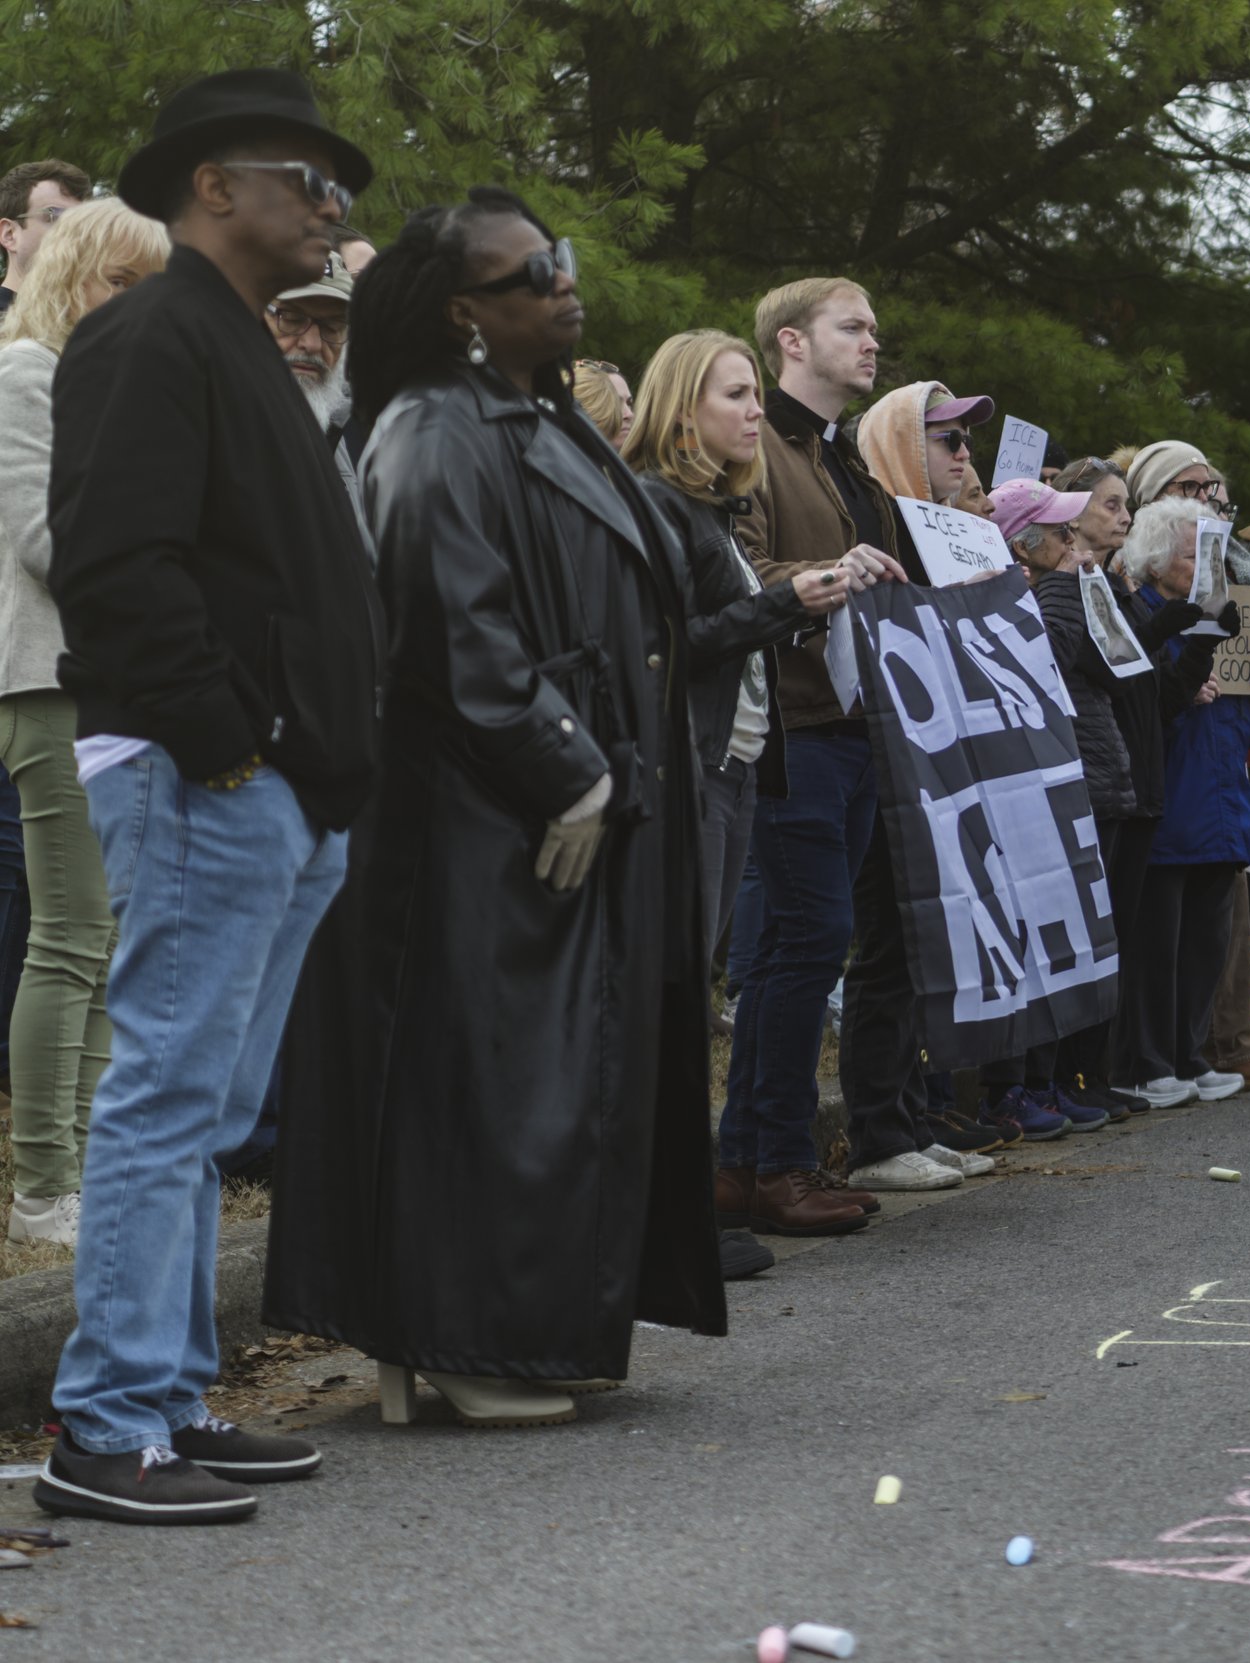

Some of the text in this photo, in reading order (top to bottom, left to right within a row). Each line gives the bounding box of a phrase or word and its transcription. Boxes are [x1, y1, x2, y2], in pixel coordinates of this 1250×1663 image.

[1008, 423, 1037, 448] ICE
[997, 449, 1012, 470] Go
[916, 505, 959, 537] ICE
